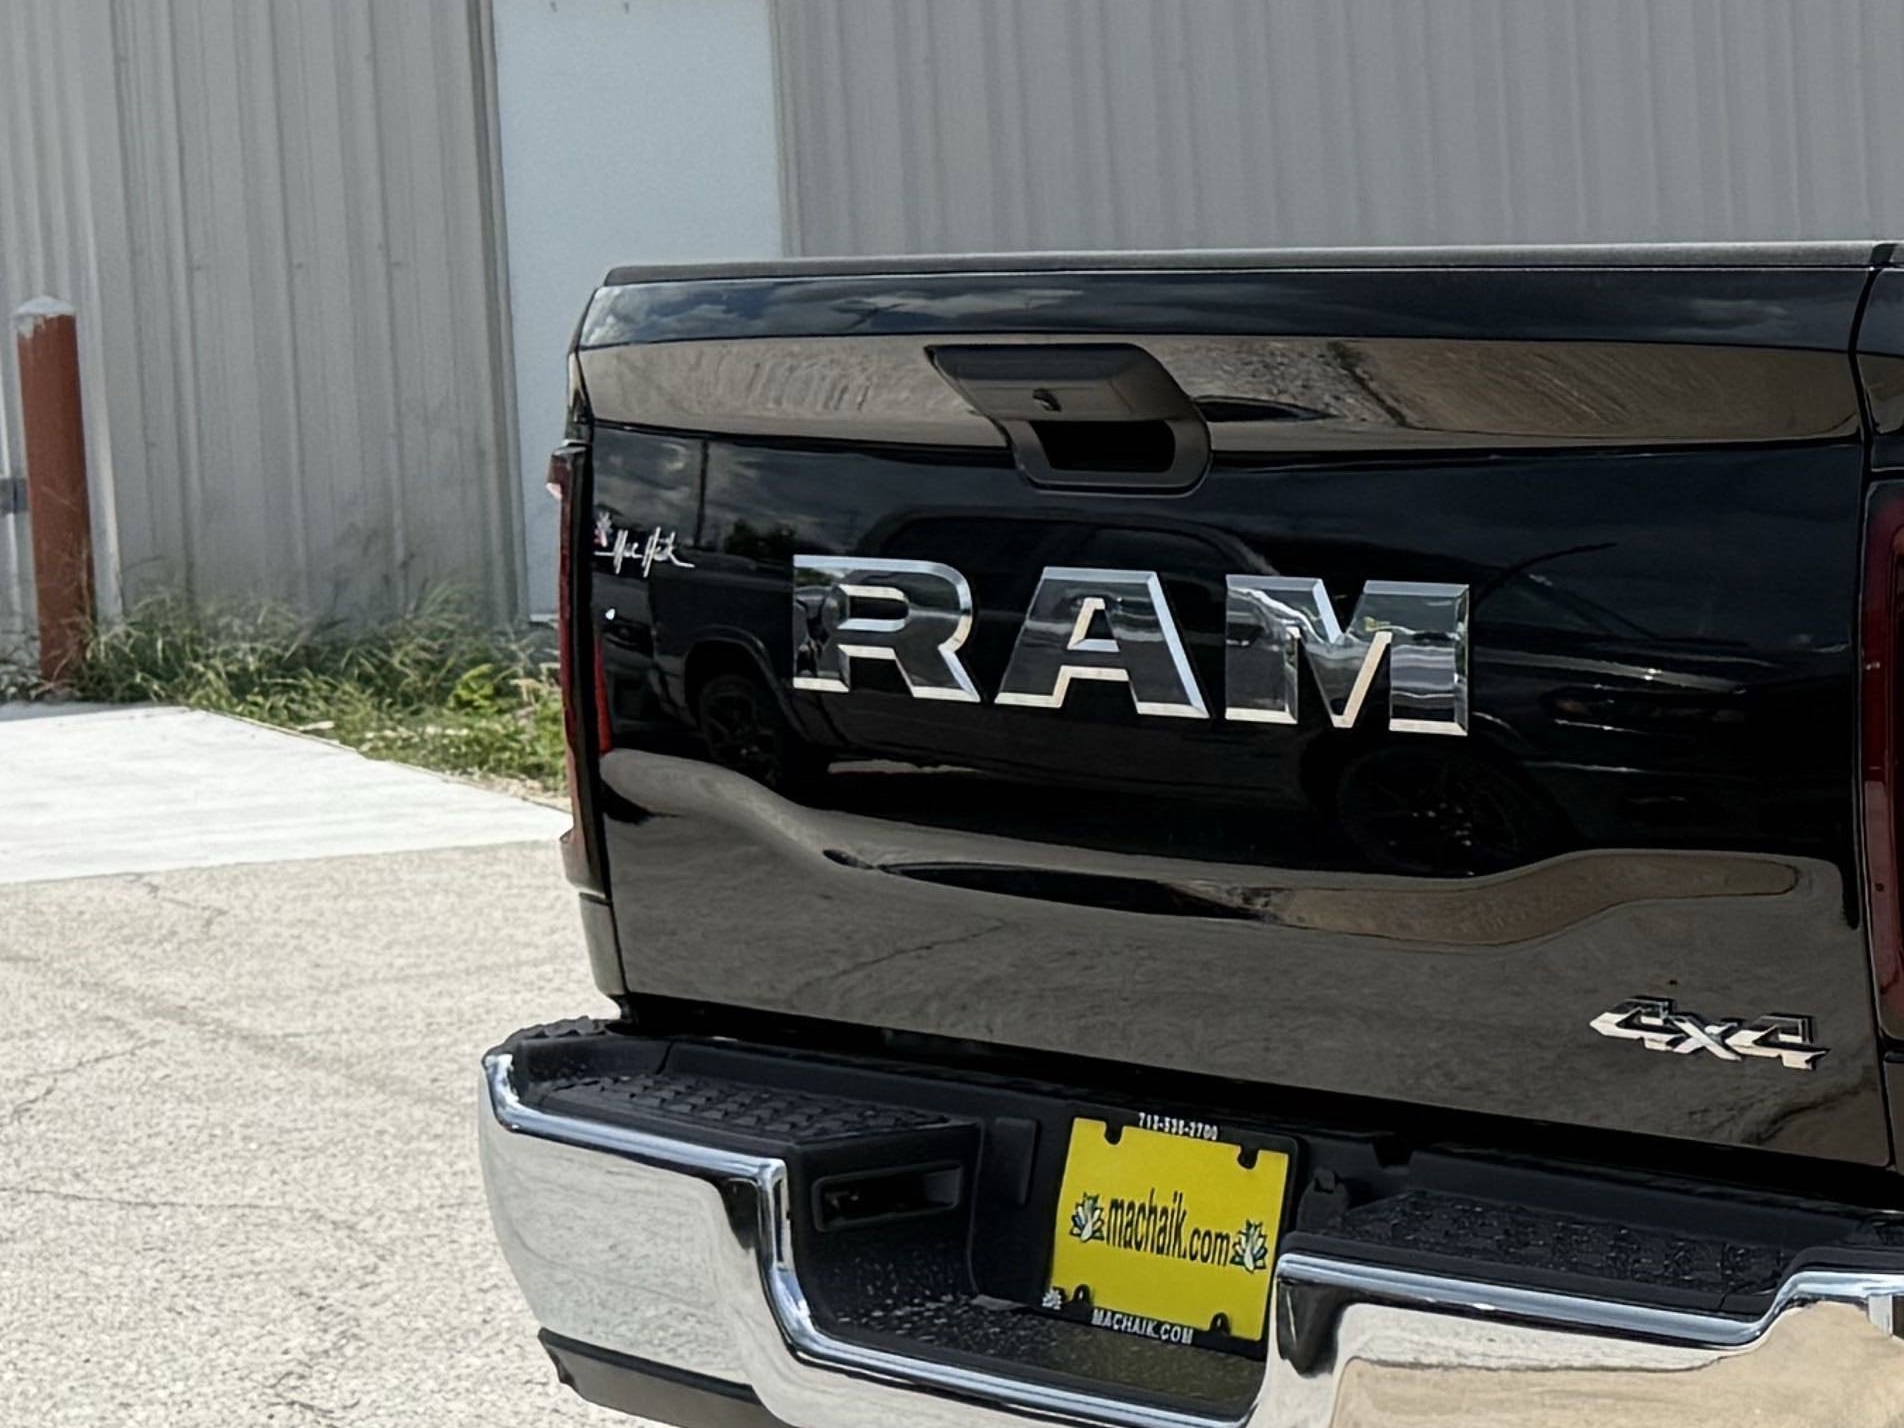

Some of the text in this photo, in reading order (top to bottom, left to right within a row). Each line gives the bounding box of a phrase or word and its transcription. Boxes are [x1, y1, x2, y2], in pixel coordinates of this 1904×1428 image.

[793, 554, 1470, 736] RAM
[1105, 1187, 1230, 1267] machaik.com
[1090, 1308, 1194, 1345] MACHAIK.COM
